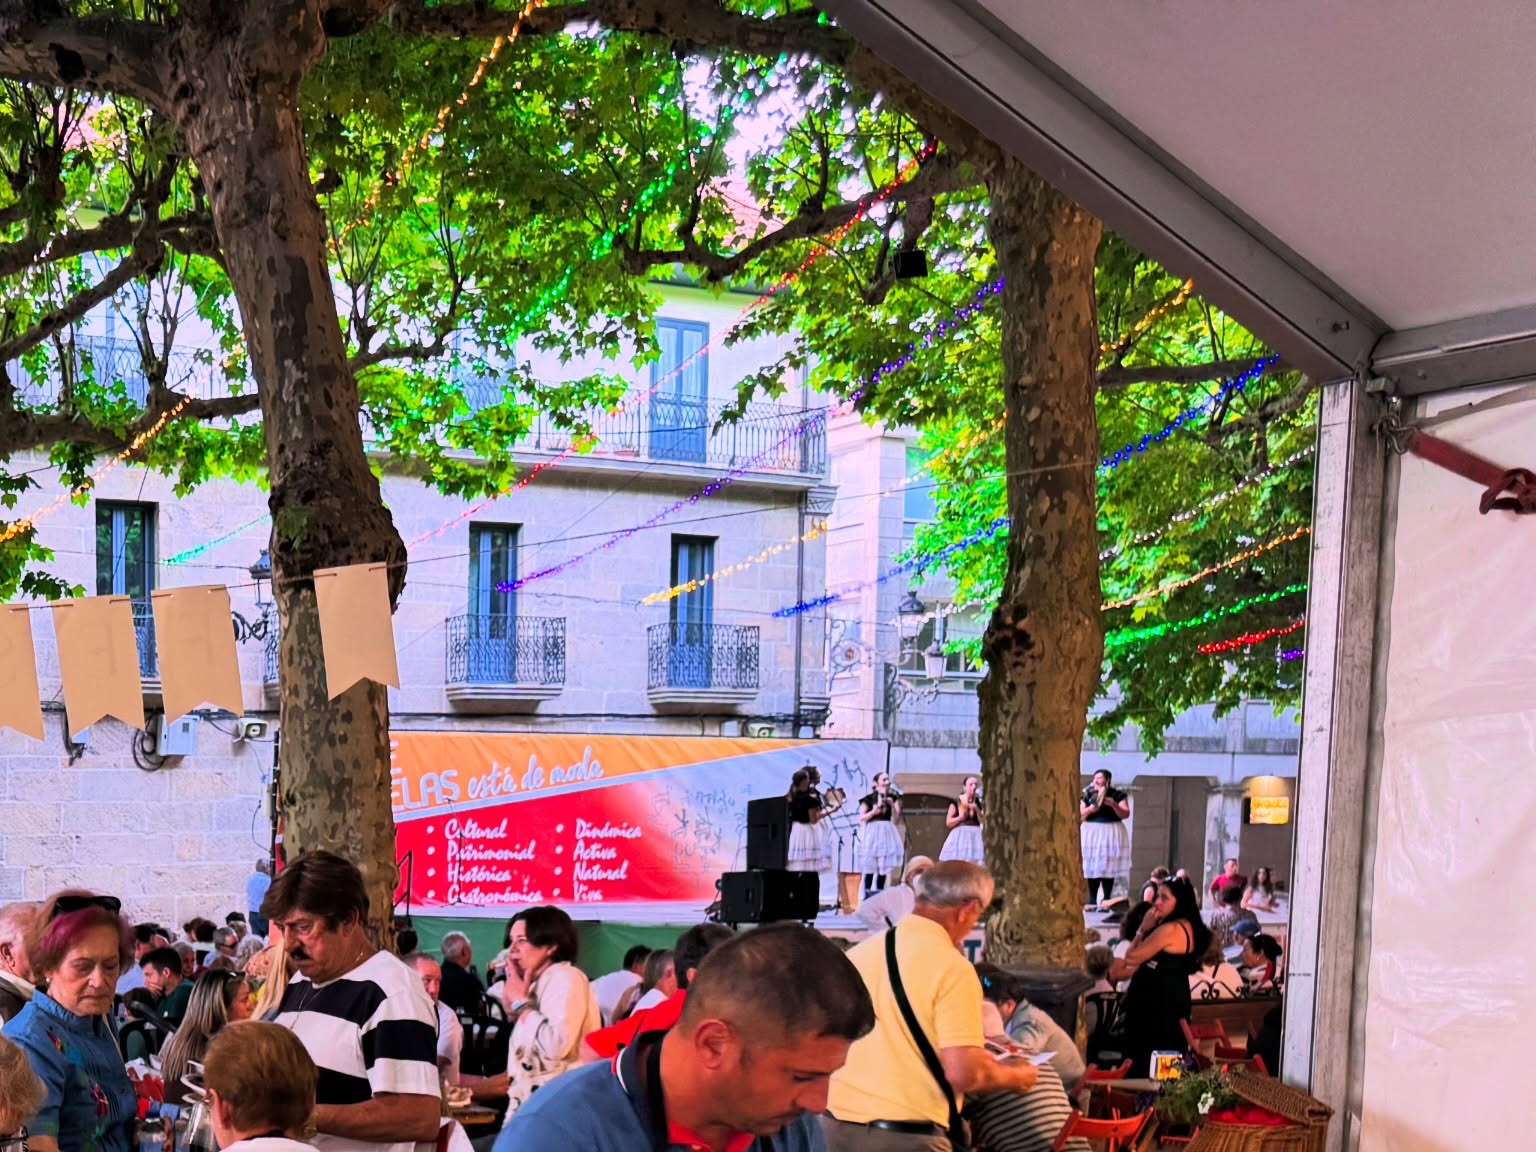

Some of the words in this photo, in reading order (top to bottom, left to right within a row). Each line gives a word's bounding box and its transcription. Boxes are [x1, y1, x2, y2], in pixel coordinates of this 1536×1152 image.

[468, 761, 516, 798] está
[521, 754, 544, 790] de
[550, 745, 604, 785] moda
[575, 818, 642, 839] Dinámica
[573, 839, 617, 861] Activa
[447, 862, 512, 882] Histórica
[573, 860, 629, 881] Natural
[573, 881, 603, 901] Viva
